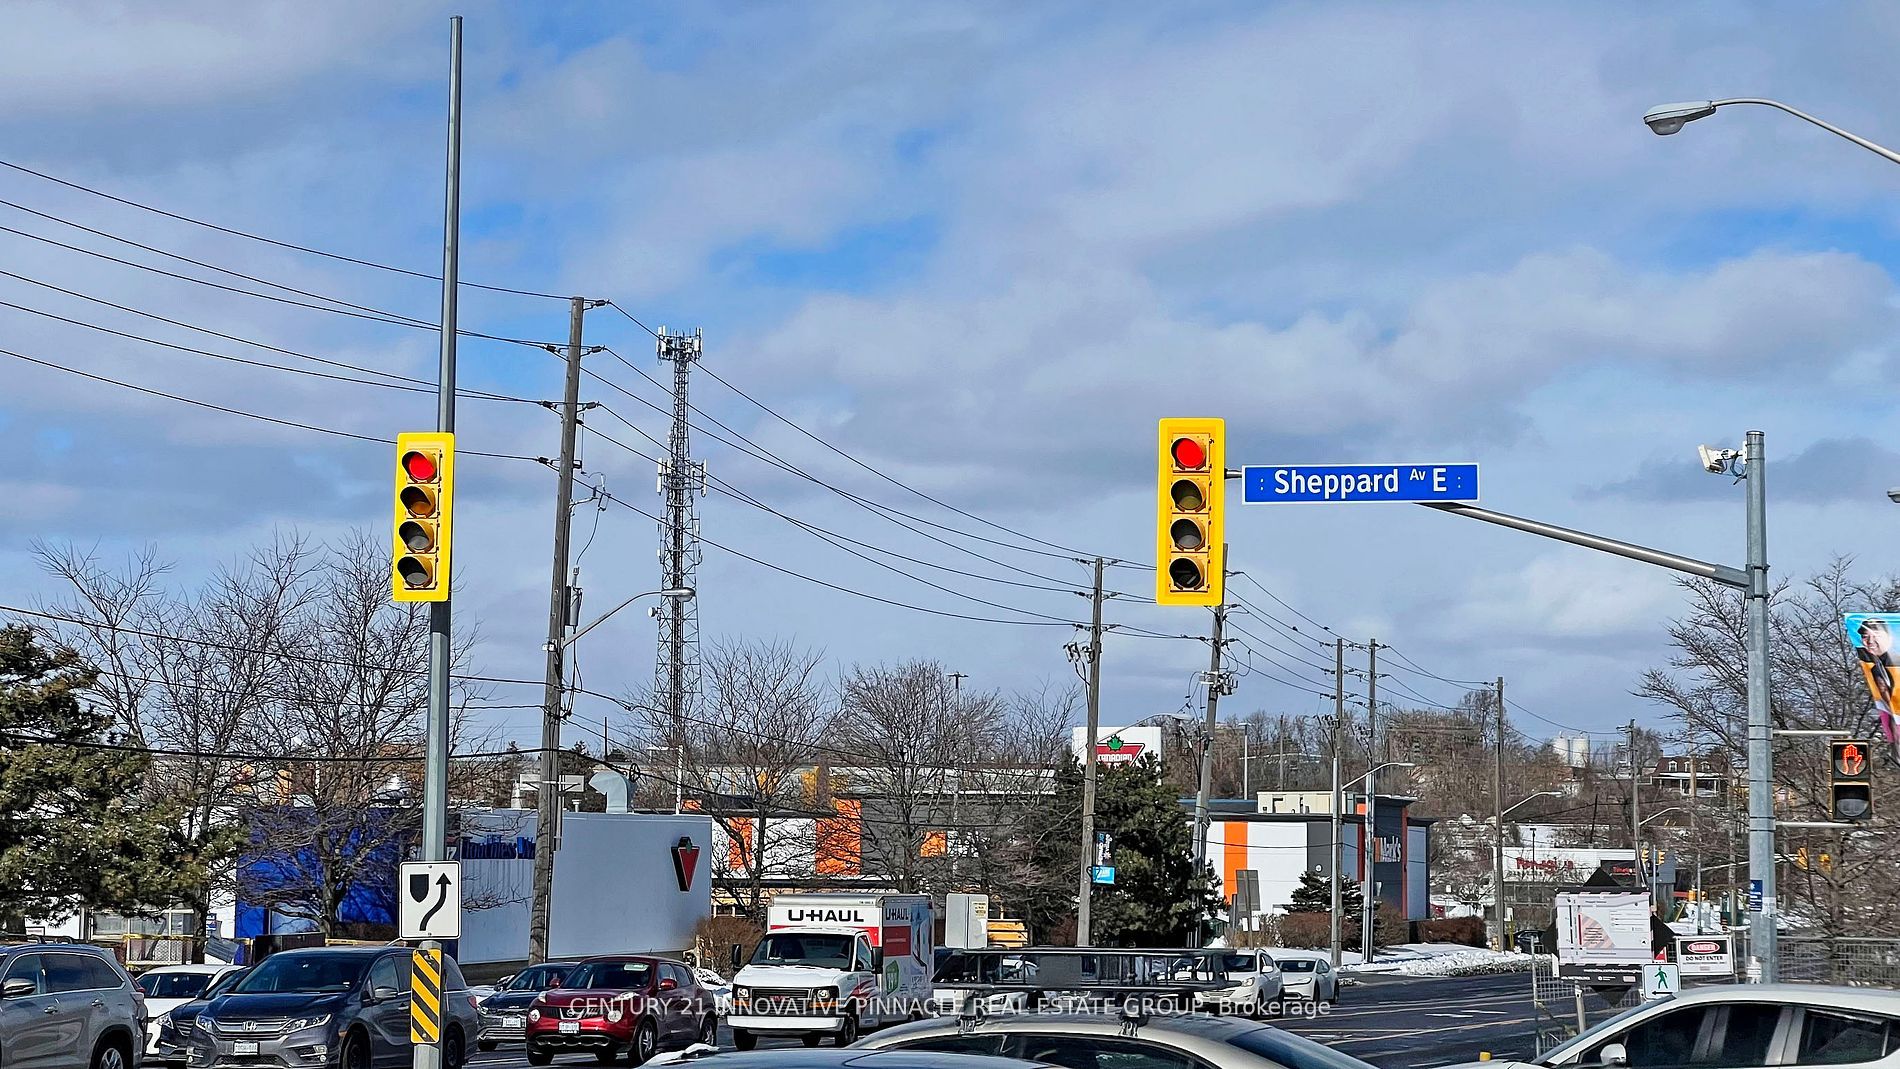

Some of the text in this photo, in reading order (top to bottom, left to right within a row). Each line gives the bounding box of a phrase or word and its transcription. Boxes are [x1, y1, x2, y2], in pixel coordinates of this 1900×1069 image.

[1274, 468, 1447, 499] Sheppard Av E
